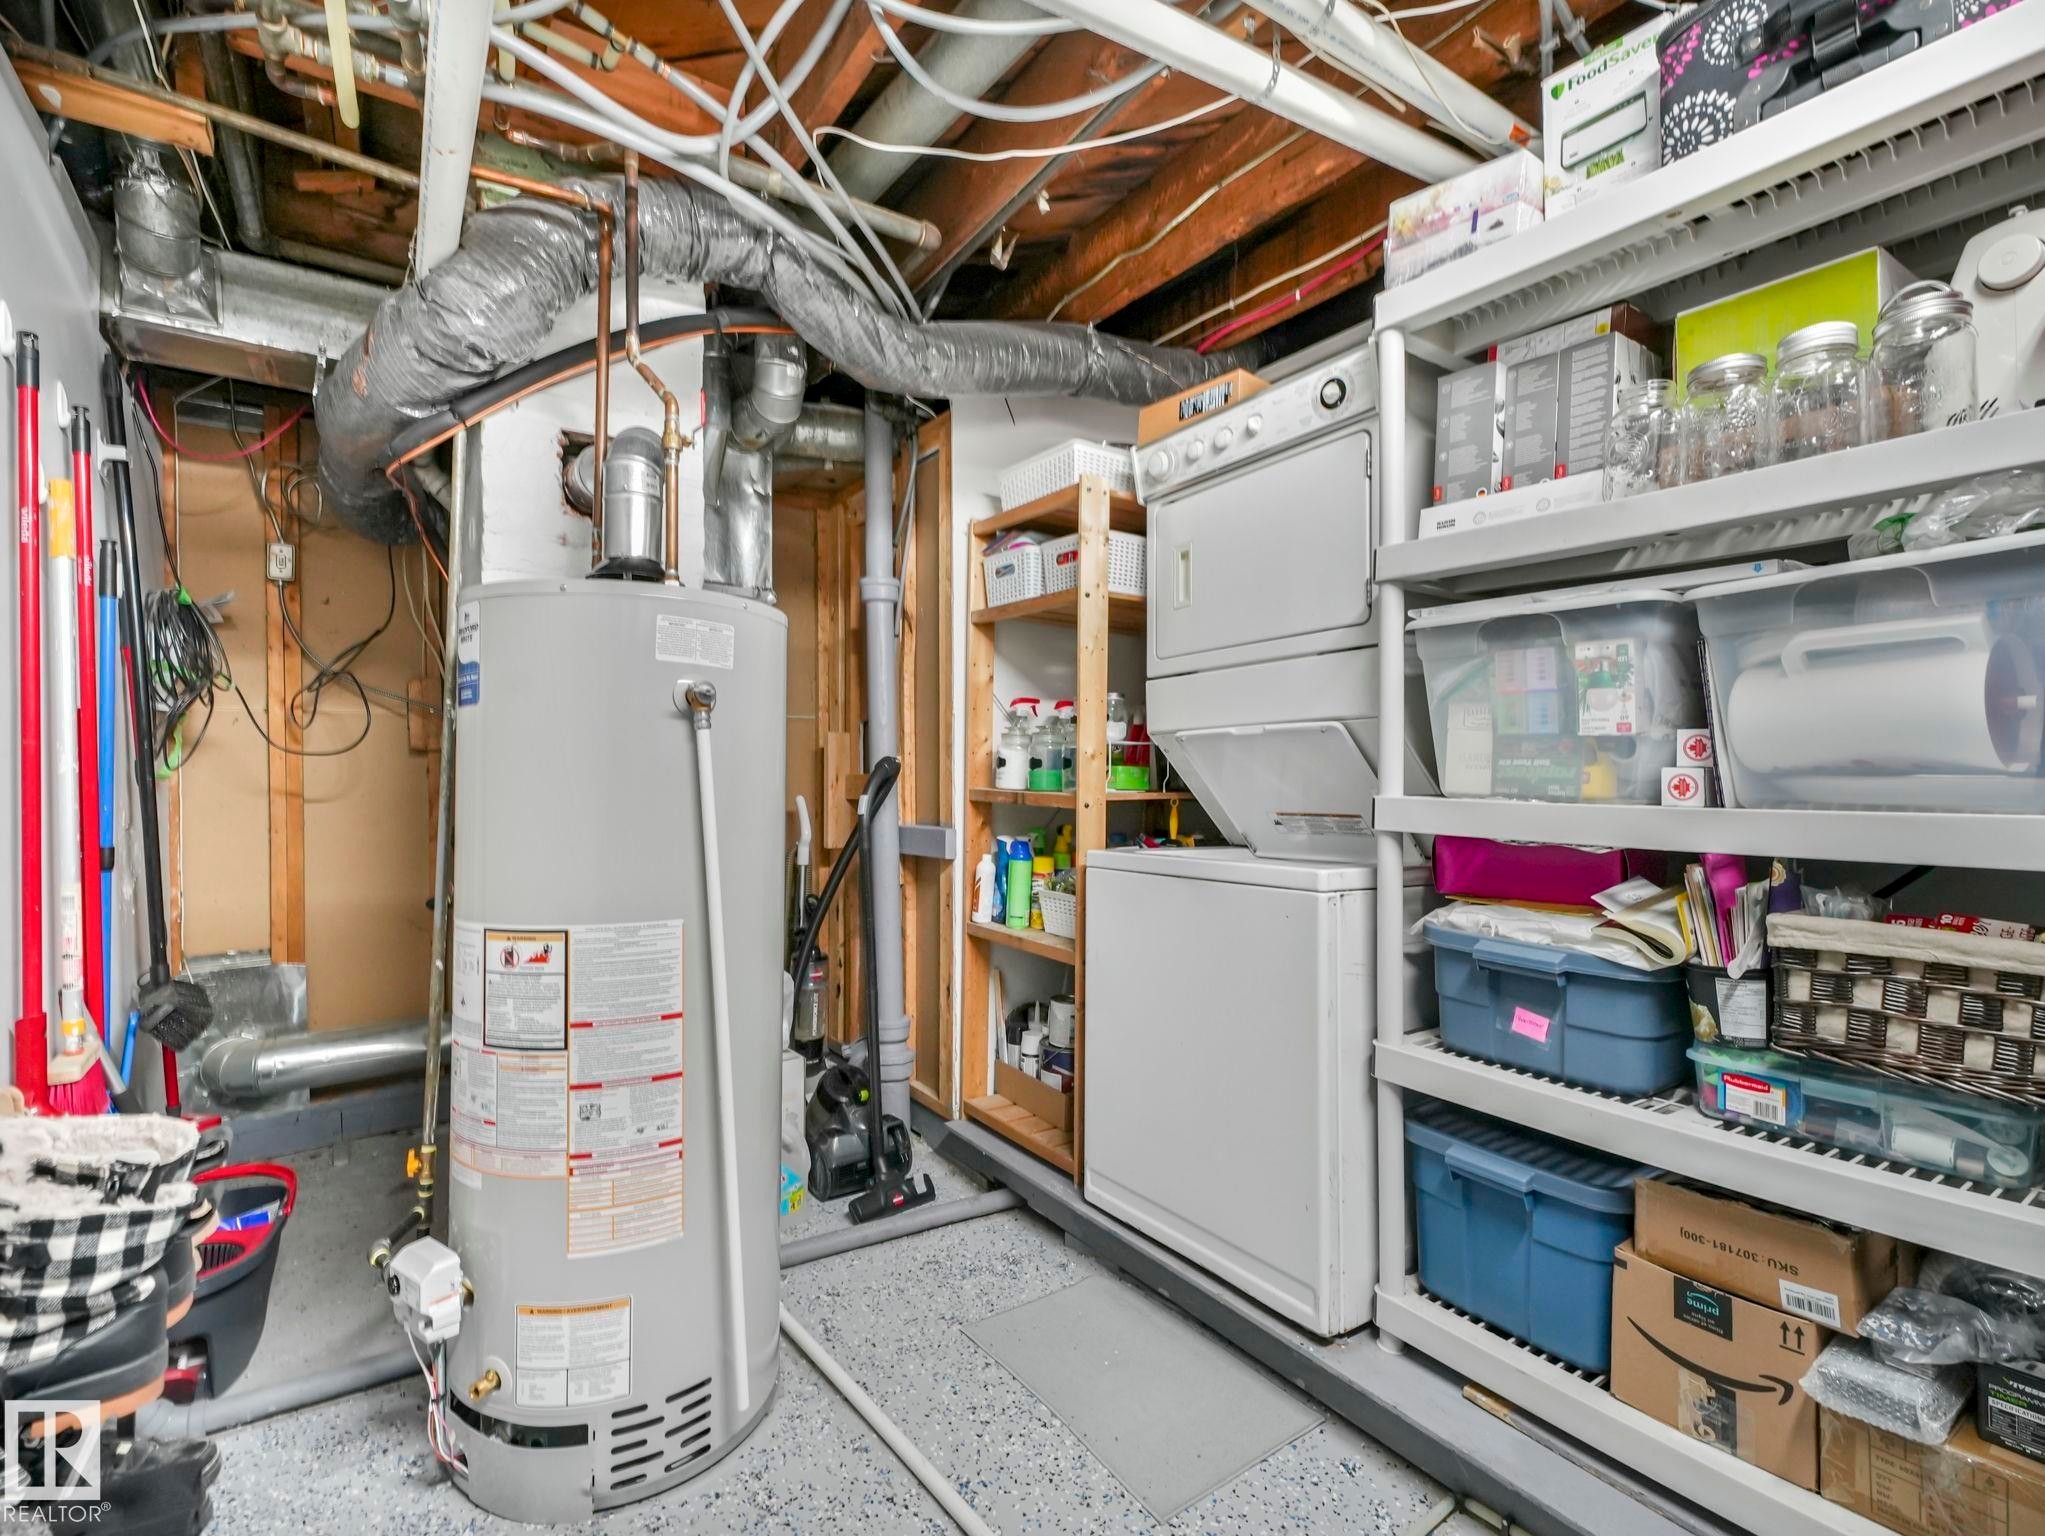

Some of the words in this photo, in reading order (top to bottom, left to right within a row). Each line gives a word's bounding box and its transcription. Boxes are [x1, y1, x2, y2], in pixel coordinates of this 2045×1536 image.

[1568, 31, 1660, 91] FoodSaver
[1723, 1074, 1770, 1092] Rubbermaid
[1686, 1297, 1720, 1317] prime
